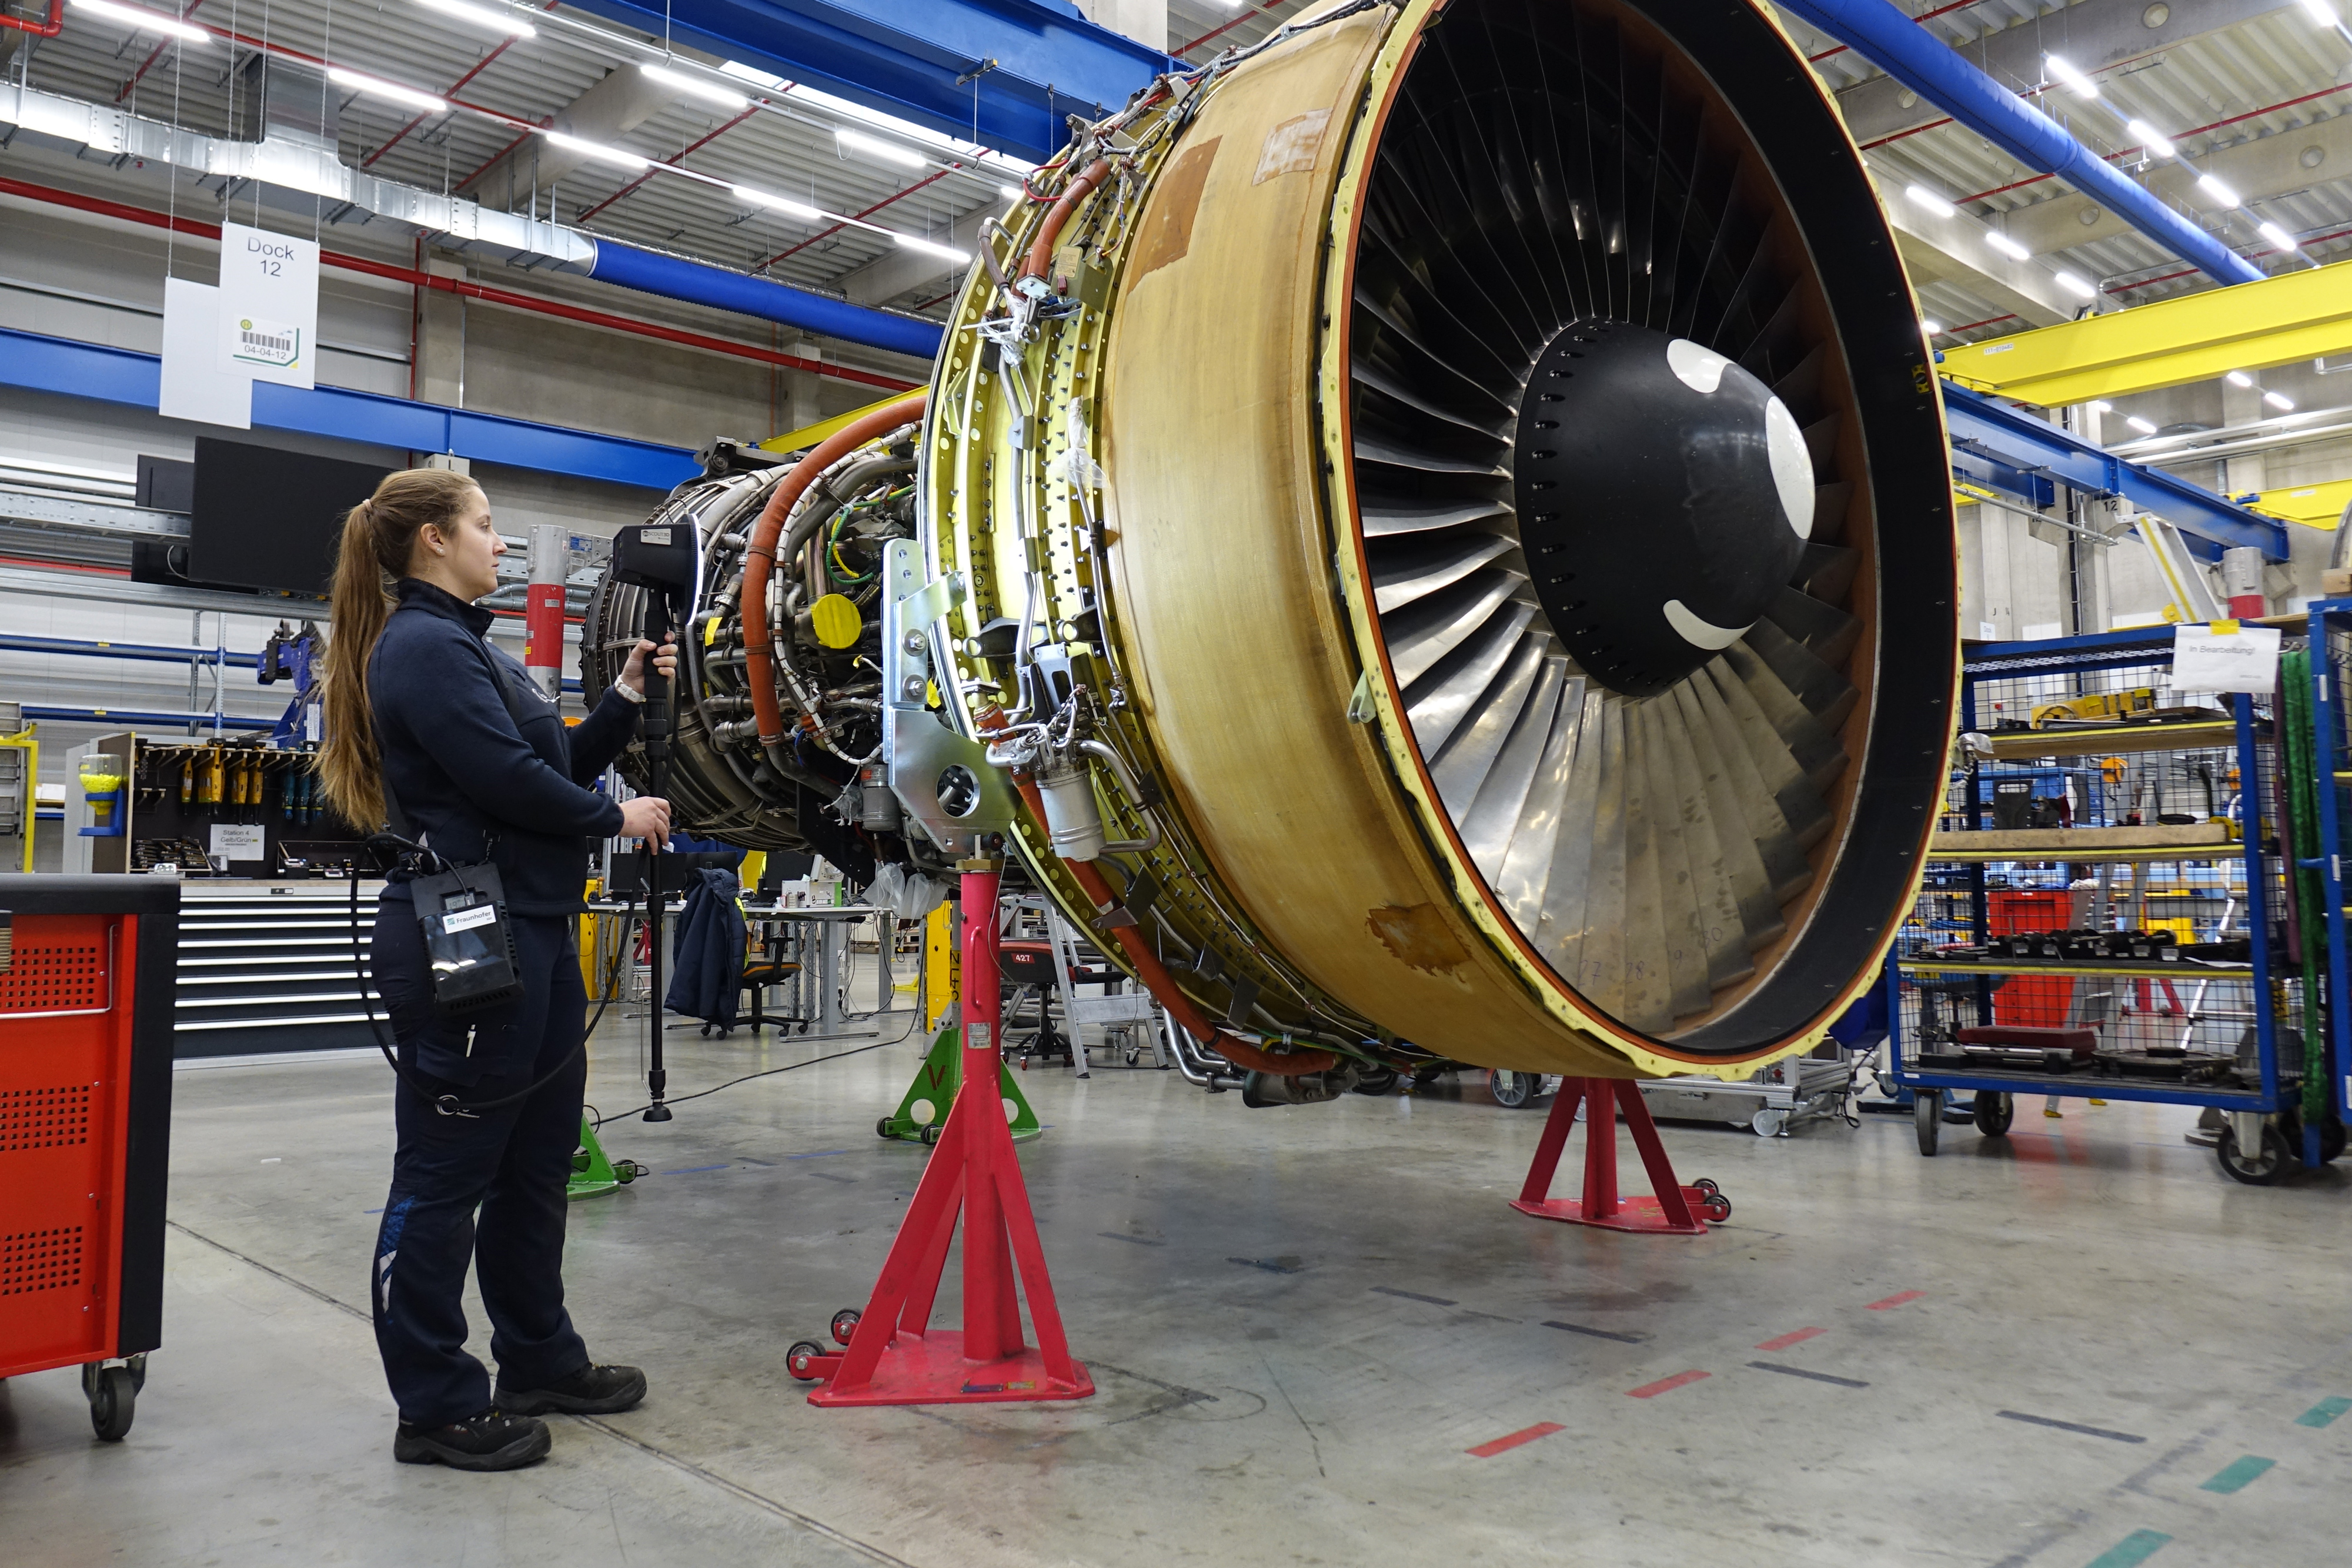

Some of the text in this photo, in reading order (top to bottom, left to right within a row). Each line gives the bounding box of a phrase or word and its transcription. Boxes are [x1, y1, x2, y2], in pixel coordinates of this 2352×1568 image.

[248, 236, 294, 260] Dock
[260, 259, 280, 277] 12
[245, 345, 286, 360] 04-04-12
[2103, 500, 2118, 512] 12
[2199, 646, 2256, 656] Bearbeitung!
[456, 911, 491, 924] Fraunhofer
